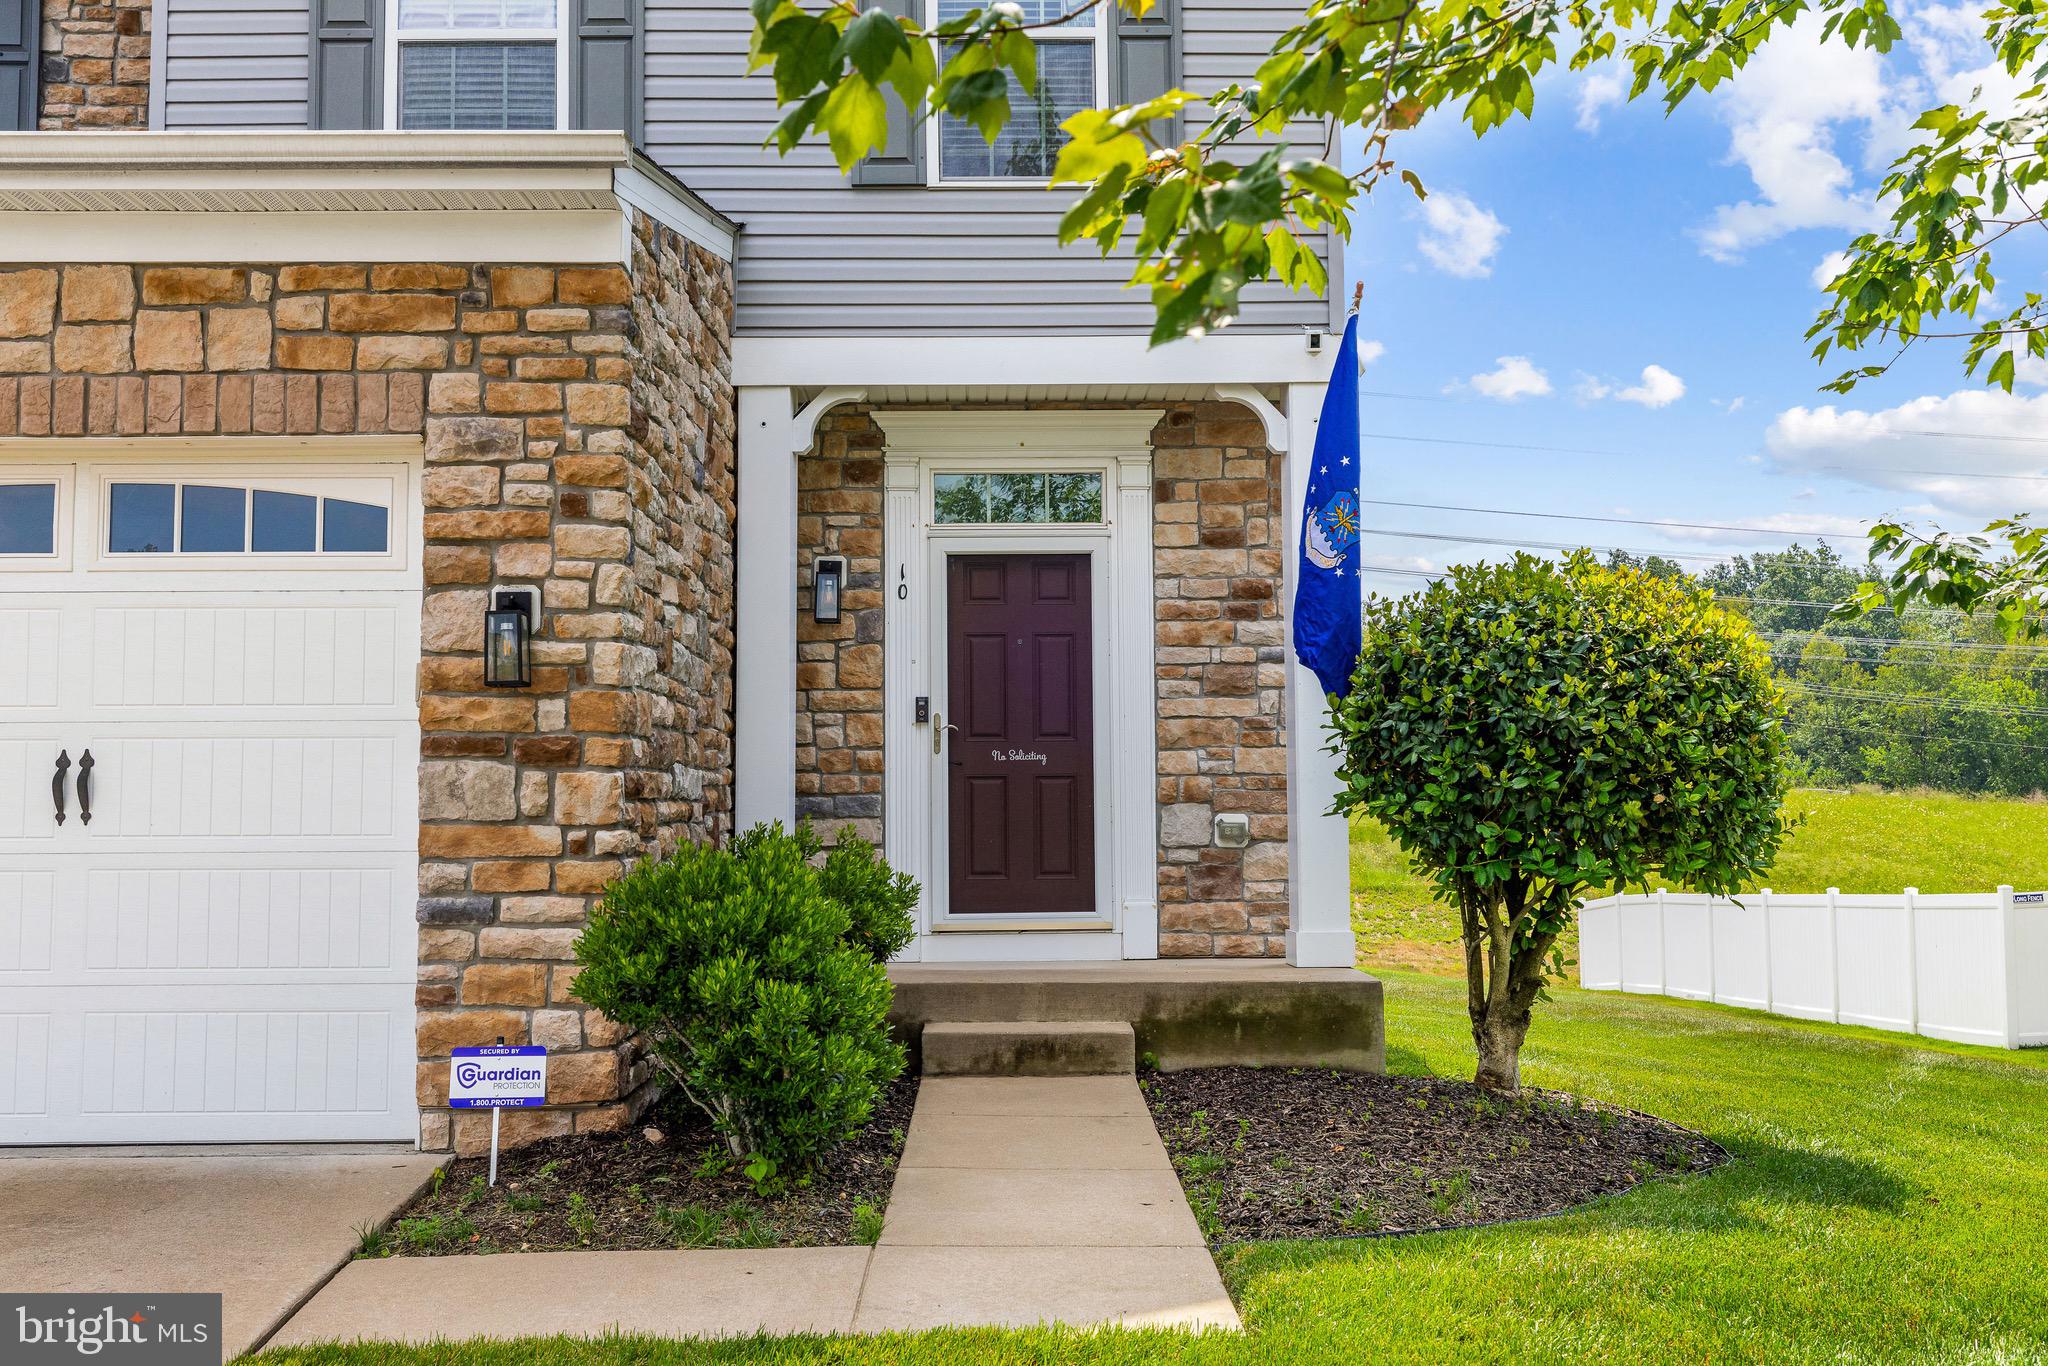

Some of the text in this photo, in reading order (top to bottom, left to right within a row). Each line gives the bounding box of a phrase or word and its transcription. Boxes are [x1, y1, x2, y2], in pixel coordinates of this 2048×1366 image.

[898, 563, 908, 600] 10
[991, 749, 1048, 766] No Soliciting
[460, 1067, 541, 1082] Guardian
[493, 1081, 541, 1090] PROTECTION
[469, 1098, 525, 1106] 1.800.PROTECT
